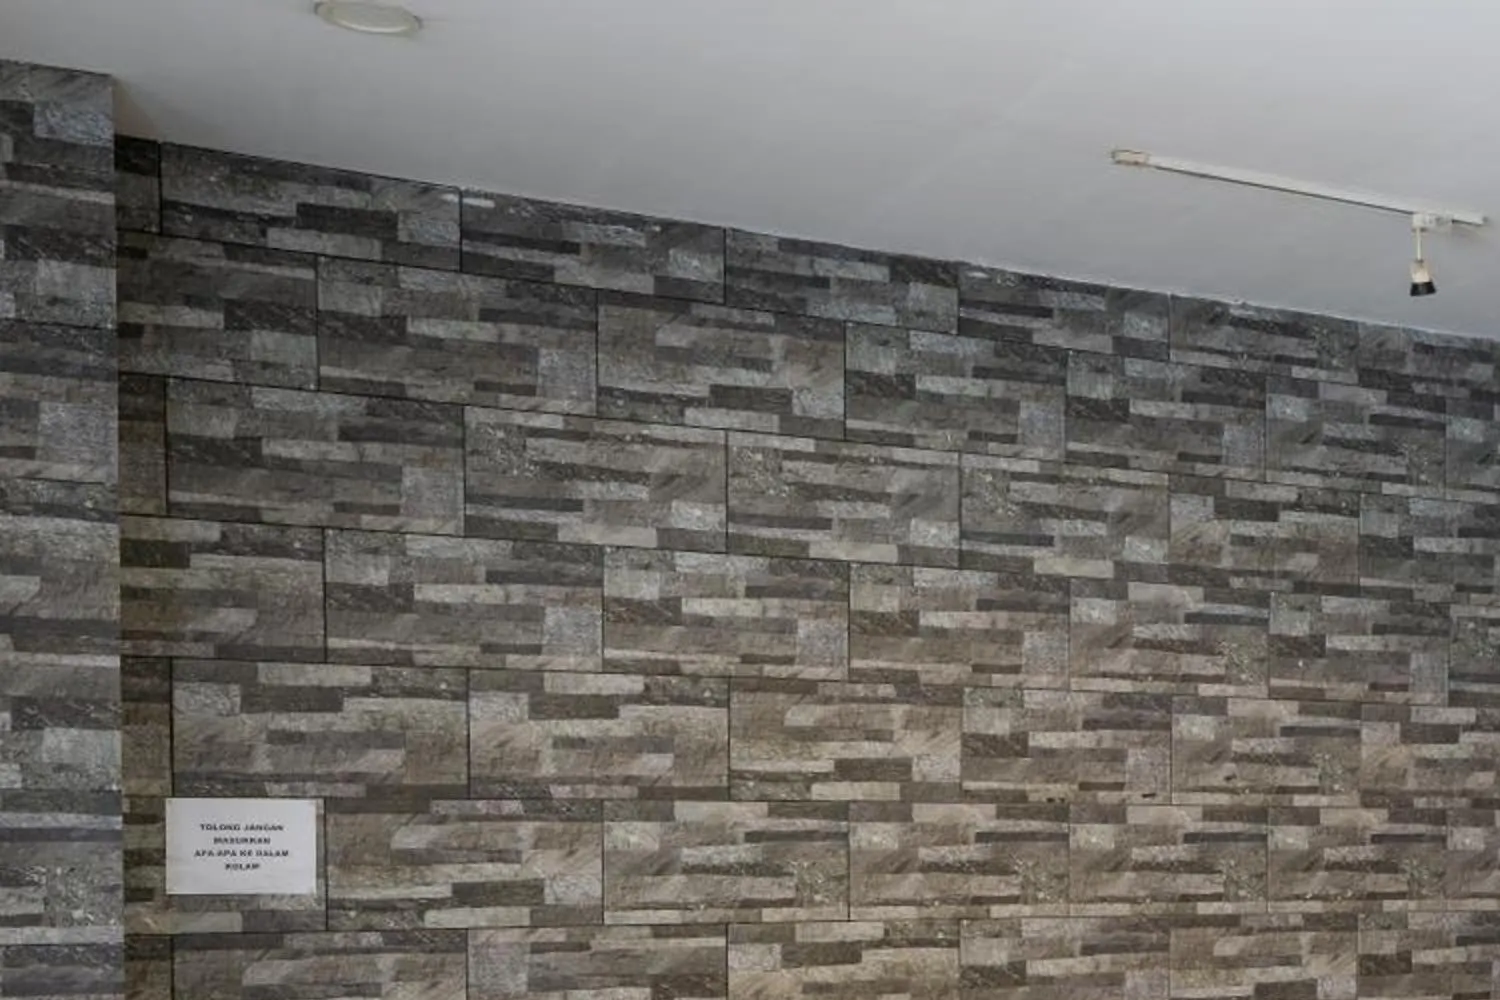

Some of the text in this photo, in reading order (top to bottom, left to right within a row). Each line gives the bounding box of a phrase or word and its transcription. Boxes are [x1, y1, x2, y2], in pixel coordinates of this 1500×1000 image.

[199, 823, 284, 831] TOLONG JANGAN
[239, 849, 253, 857] KE
